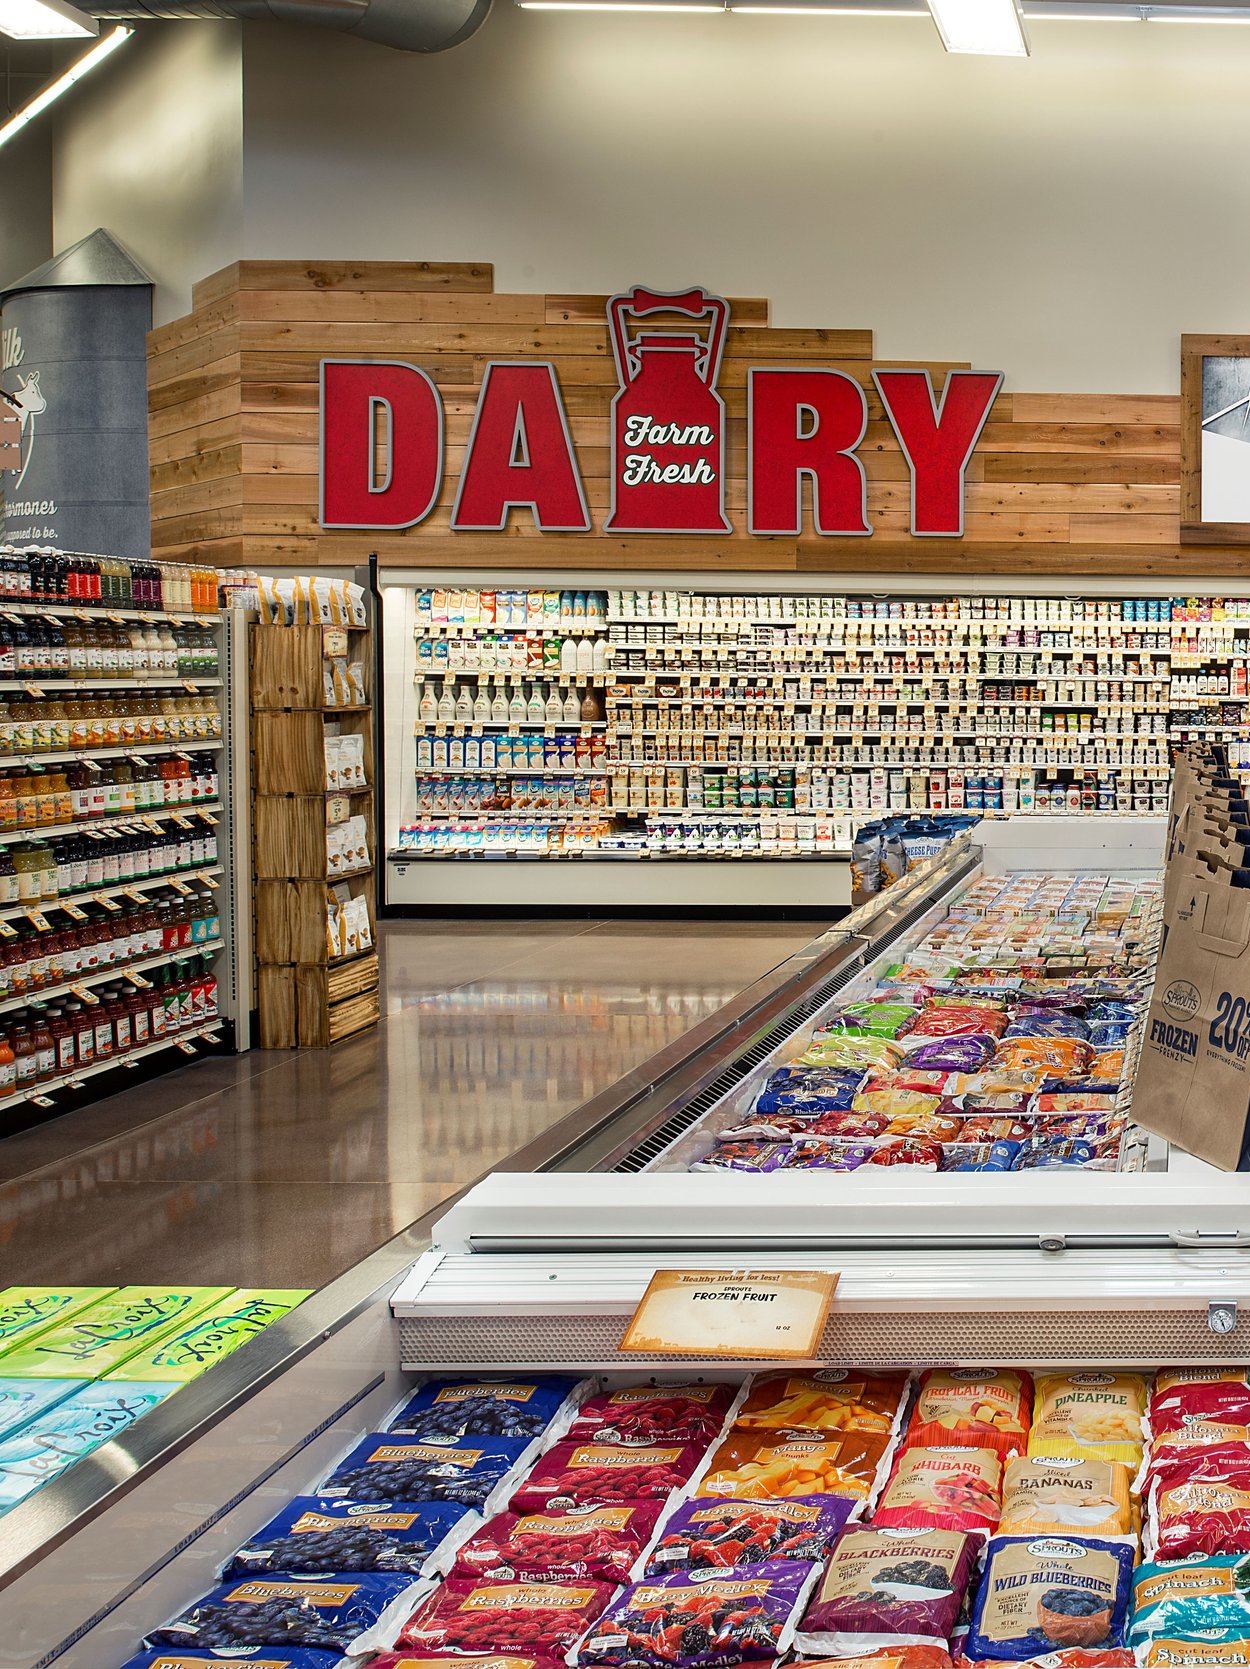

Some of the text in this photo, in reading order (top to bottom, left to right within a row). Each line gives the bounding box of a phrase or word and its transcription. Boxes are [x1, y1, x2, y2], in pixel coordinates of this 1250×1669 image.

[2, 327, 25, 369] ilk
[622, 415, 715, 448] Farm
[622, 454, 716, 488] Fresh
[32, 527, 42, 539] to
[43, 526, 58, 539] be.
[1163, 990, 1199, 1009] SPROUTS
[1150, 1019, 1199, 1058] FROZEN
[1159, 1048, 1185, 1063] FRENZY
[1206, 1050, 1230, 1066] EVERYTHING
[682, 1275, 716, 1284] Healthy
[717, 1274, 744, 1283] living
[760, 1274, 780, 1282] less!
[692, 1292, 777, 1302] FROZEN FRUIT
[953, 1371, 997, 1379] SPROUTS
[1070, 1375, 1115, 1383] SPROUTS
[1178, 1372, 1221, 1381] Blend
[800, 1380, 852, 1394] Mango
[924, 1385, 1015, 1402] TROPICAL FRUIT
[1055, 1393, 1128, 1409] PINEAPPLE
[379, 1448, 474, 1461] Blueberries
[772, 1445, 826, 1456] Mango
[576, 1453, 673, 1467] Raspberries
[911, 1460, 981, 1475] RHUBARB
[1043, 1468, 1071, 1477] Sliced
[1020, 1478, 1093, 1491] BANANAS
[836, 1548, 955, 1562] BLACKBERRIES
[1031, 1543, 1085, 1556] SPROUTS
[1036, 1562, 1074, 1571] Whole
[994, 1572, 1112, 1594] WILD BLUEBERRIES
[1144, 1576, 1225, 1599] Spinach
[239, 1584, 346, 1600] Blueberries
[638, 1581, 768, 1604] Berry Medley
[470, 1594, 583, 1607] Raspberries
[998, 1601, 1028, 1611] DIETARY
[1002, 1607, 1023, 1615] FIBER
[1156, 1648, 1248, 1666] Spinach
[1201, 1647, 1224, 1655] leaf
